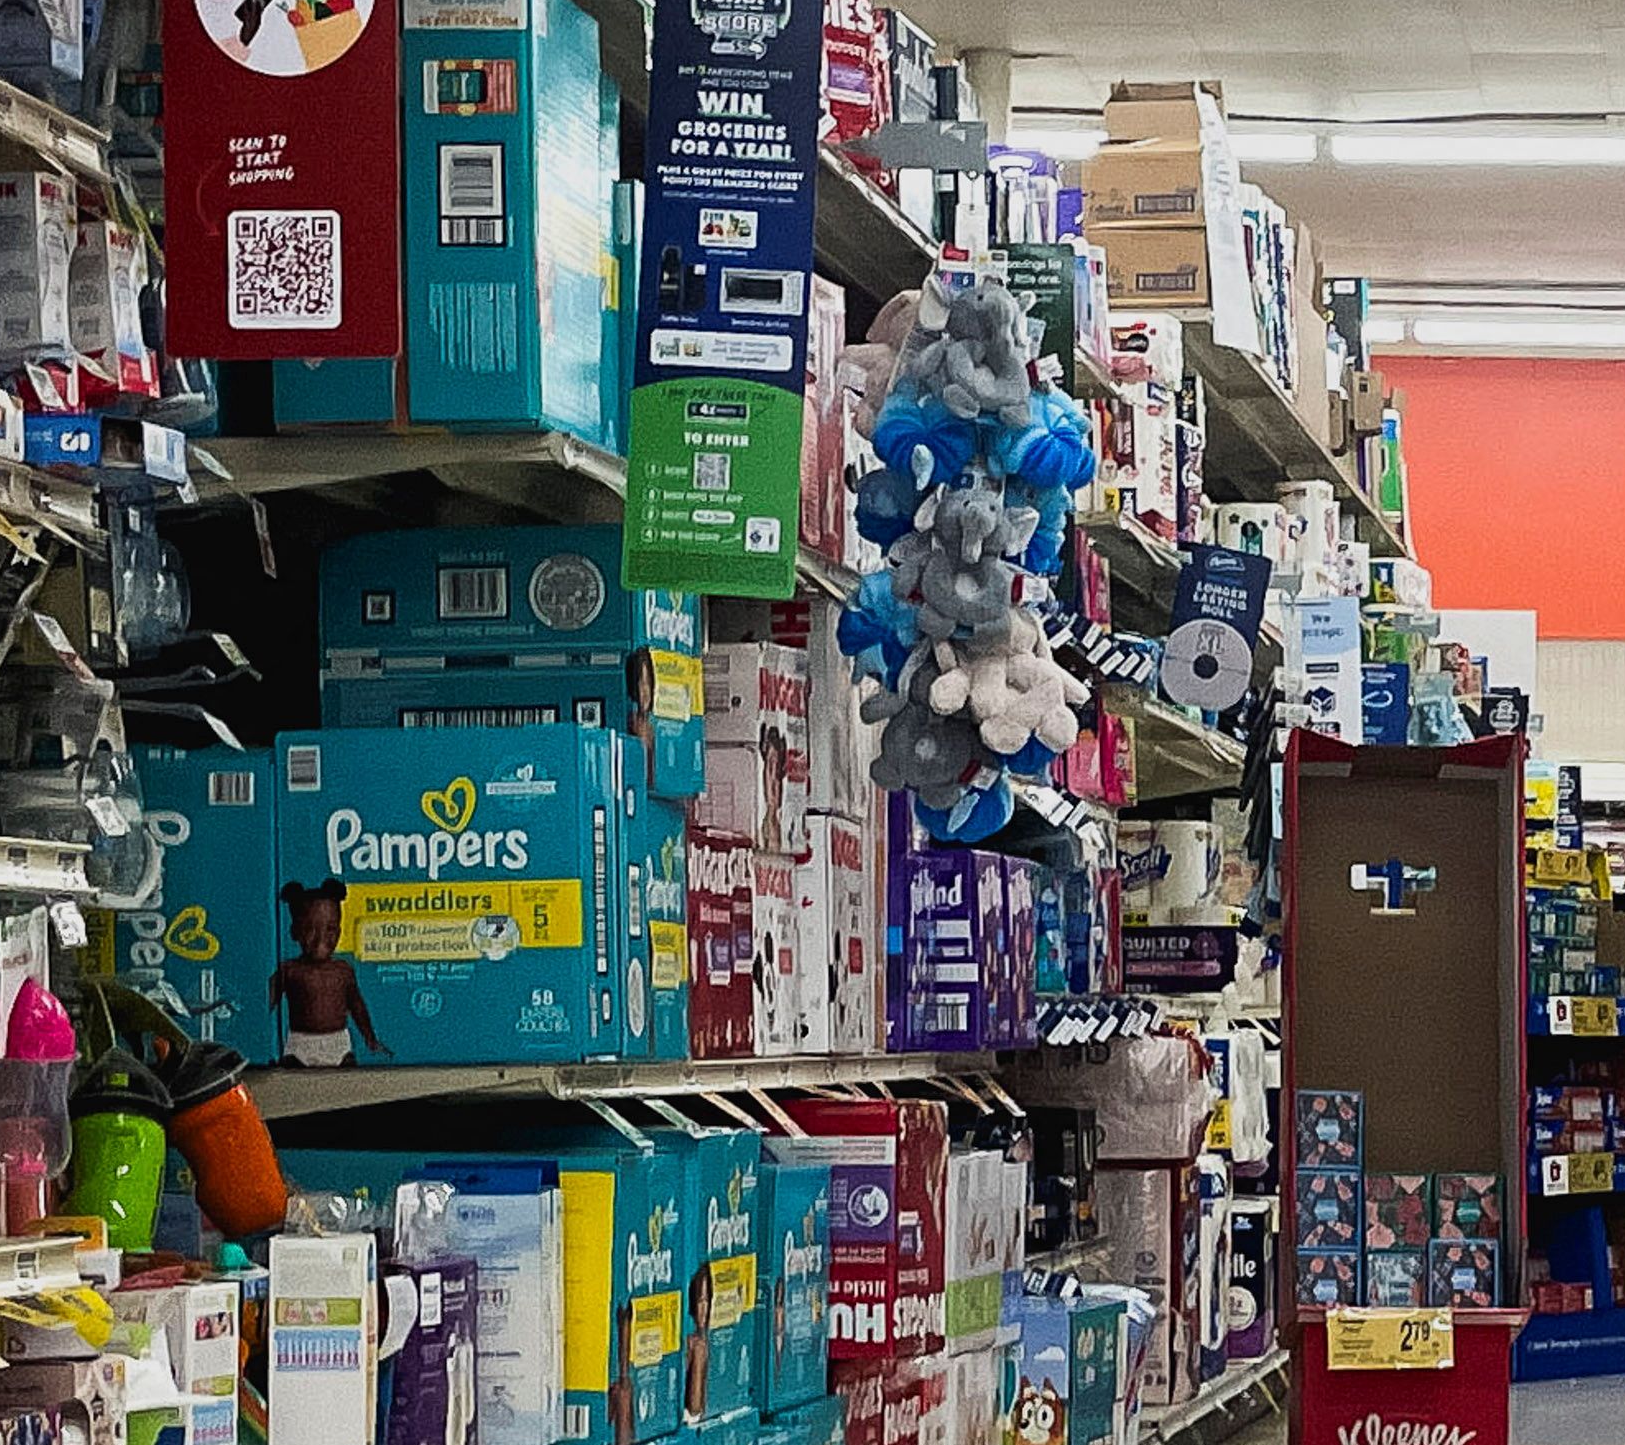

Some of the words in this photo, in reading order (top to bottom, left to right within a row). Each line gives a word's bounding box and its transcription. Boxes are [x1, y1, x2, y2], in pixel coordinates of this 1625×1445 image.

[704, 14, 775, 34] SCORE
[697, 91, 764, 115] WIN
[678, 121, 787, 140] GROCERIES
[229, 136, 263, 152] SCAN
[671, 139, 710, 155] FOR
[714, 143, 729, 157] A
[732, 143, 795, 160] YEAR!
[235, 151, 282, 167] START
[228, 166, 295, 187] SHOPPING
[326, 808, 529, 880] Pampers
[366, 889, 494, 913] swaddlers
[532, 904, 549, 930] 5
[1123, 934, 1193, 952] QUILTED
[626, 1232, 673, 1293] Pampers
